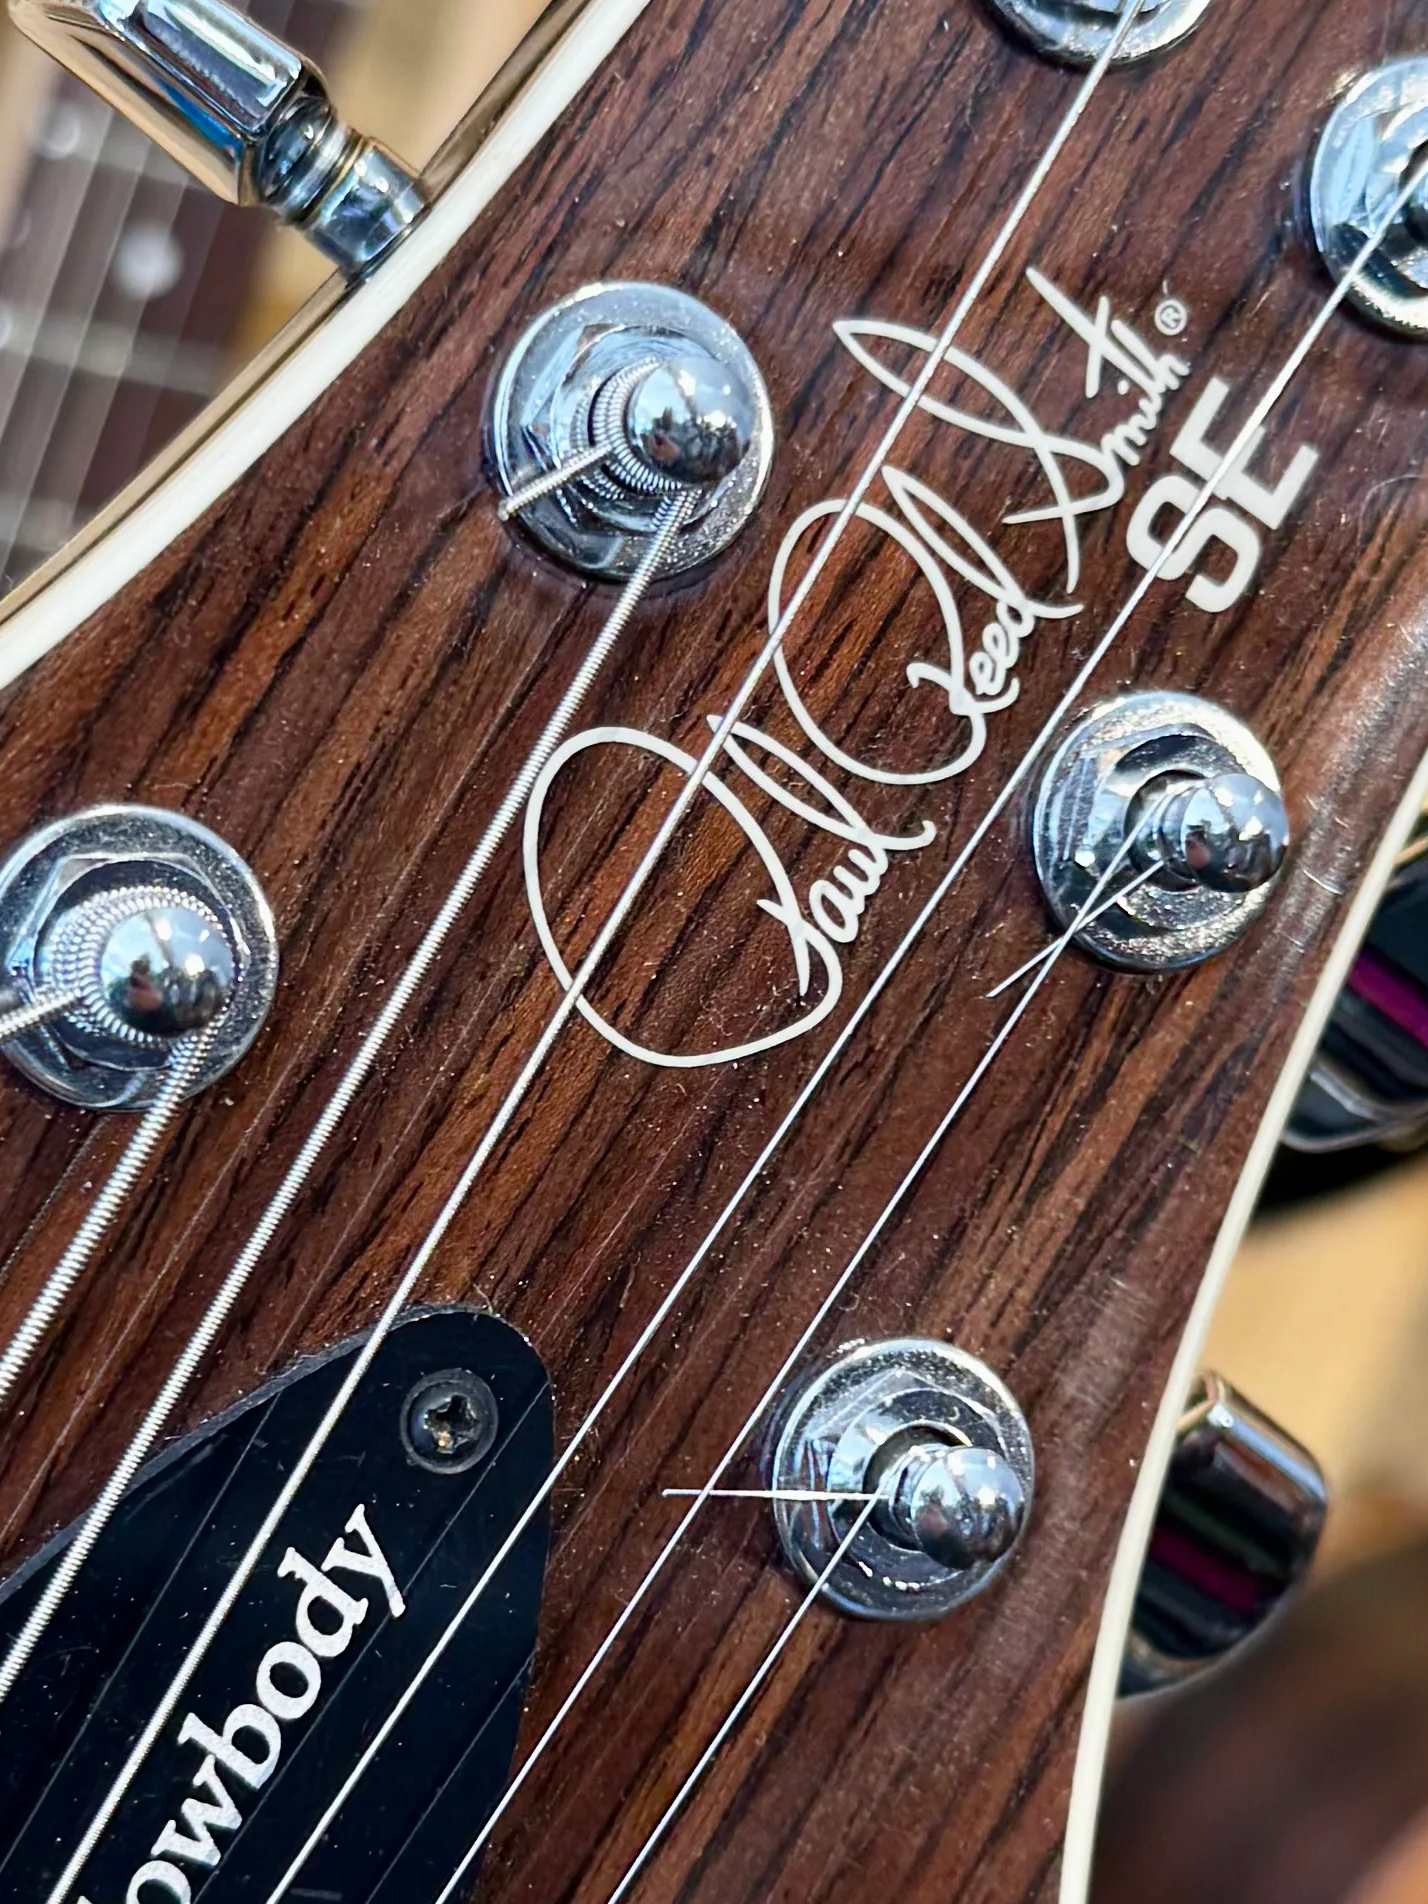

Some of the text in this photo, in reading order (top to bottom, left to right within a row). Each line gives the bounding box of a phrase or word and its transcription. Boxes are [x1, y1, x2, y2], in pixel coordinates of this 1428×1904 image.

[1126, 376, 1320, 614] SE
[524, 714, 935, 1069] Paul
[768, 464, 1083, 786] Reed
